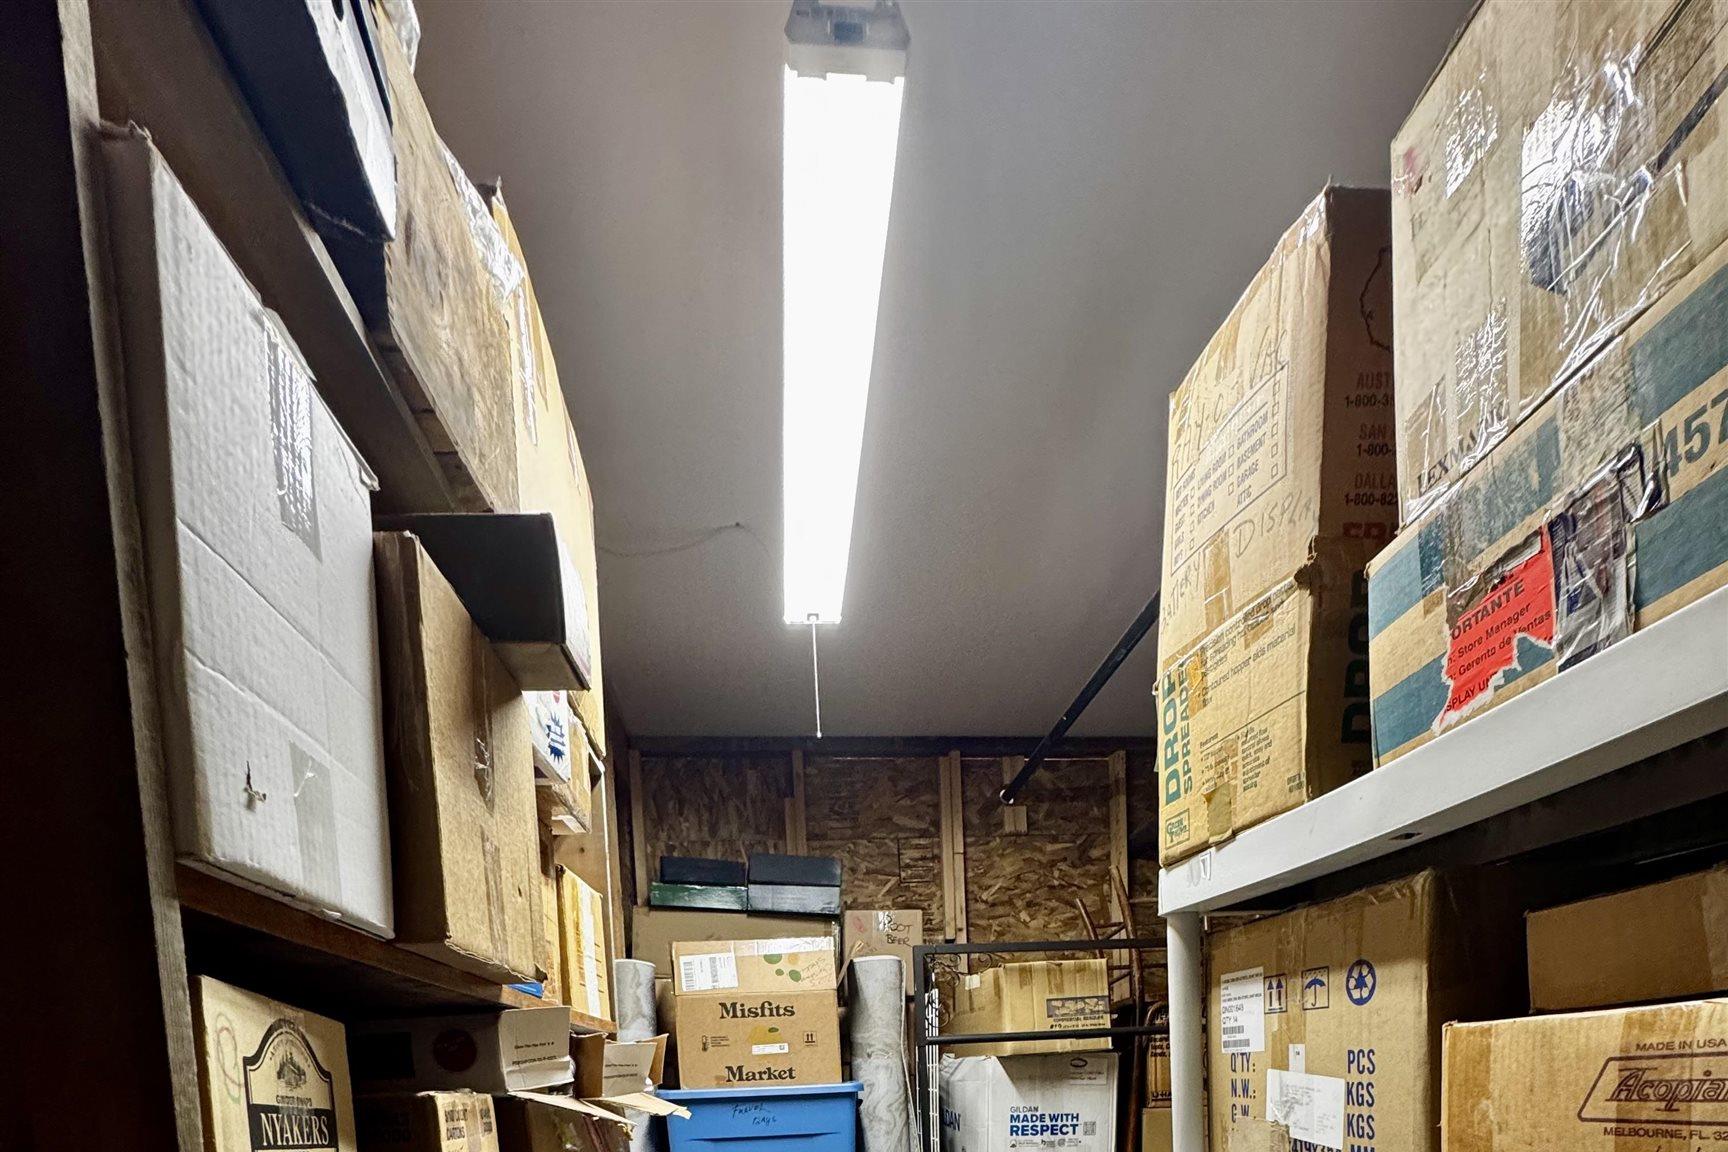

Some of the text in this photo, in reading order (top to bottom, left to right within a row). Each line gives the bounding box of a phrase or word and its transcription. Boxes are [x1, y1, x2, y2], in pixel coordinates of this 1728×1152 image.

[1451, 579, 1525, 640] ORTANTE
[1458, 635, 1483, 658] Store
[1486, 603, 1530, 640] Manager
[1163, 671, 1181, 805] DROP
[886, 933, 913, 947] BEER
[719, 1001, 795, 1019] Misfits
[1636, 1038, 1727, 1051] MADE IN USA
[1347, 1049, 1376, 1075] PCS
[725, 1065, 796, 1082] Market
[1346, 1082, 1375, 1108] KGS
[1605, 1067, 1728, 1111] Acopia
[1010, 1113, 1079, 1123] MADE WITH
[1346, 1114, 1375, 1140] KGS
[1010, 1124, 1079, 1136] RESPECT
[1604, 1127, 1687, 1140] MELBOURNE,
[1689, 1131, 1709, 1140] FL
